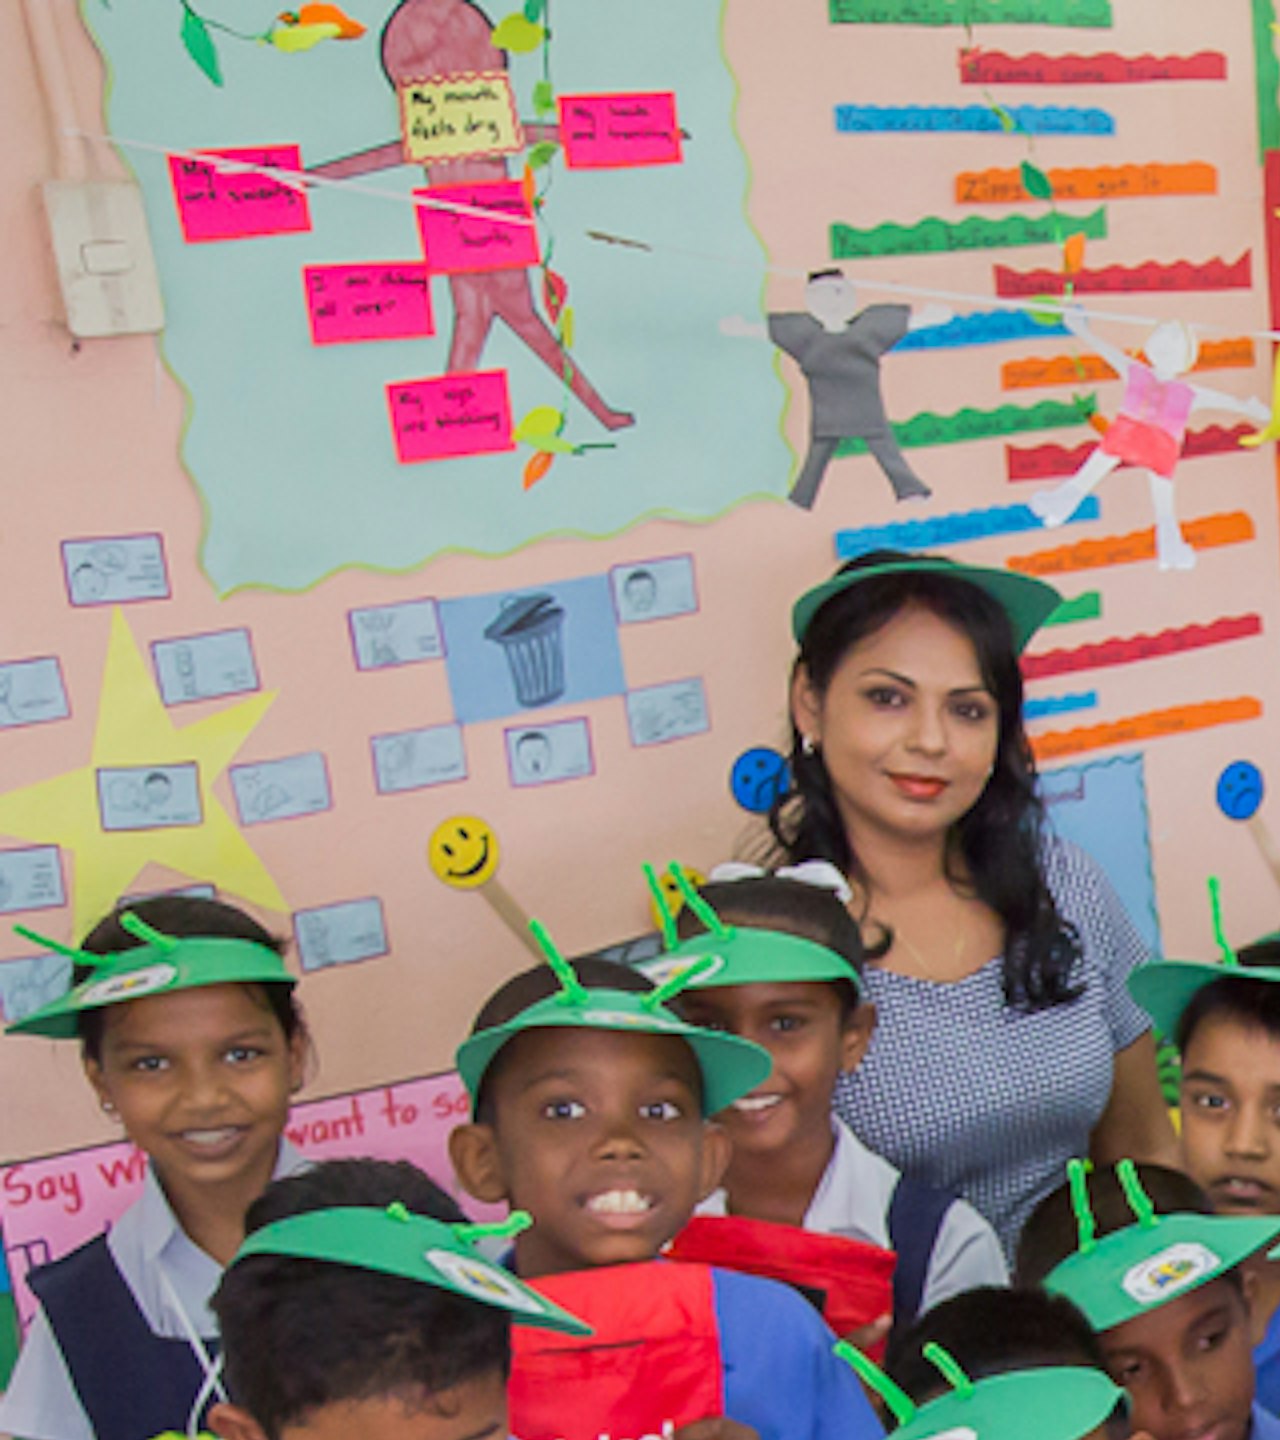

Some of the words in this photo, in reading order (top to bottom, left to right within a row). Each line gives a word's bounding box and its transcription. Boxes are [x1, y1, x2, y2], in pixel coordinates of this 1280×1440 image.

[2, 1164, 85, 1213] Say
[100, 1148, 150, 1188] wh
[284, 1100, 366, 1150] want
[381, 1087, 418, 1128] to
[433, 1090, 470, 1119] sa
